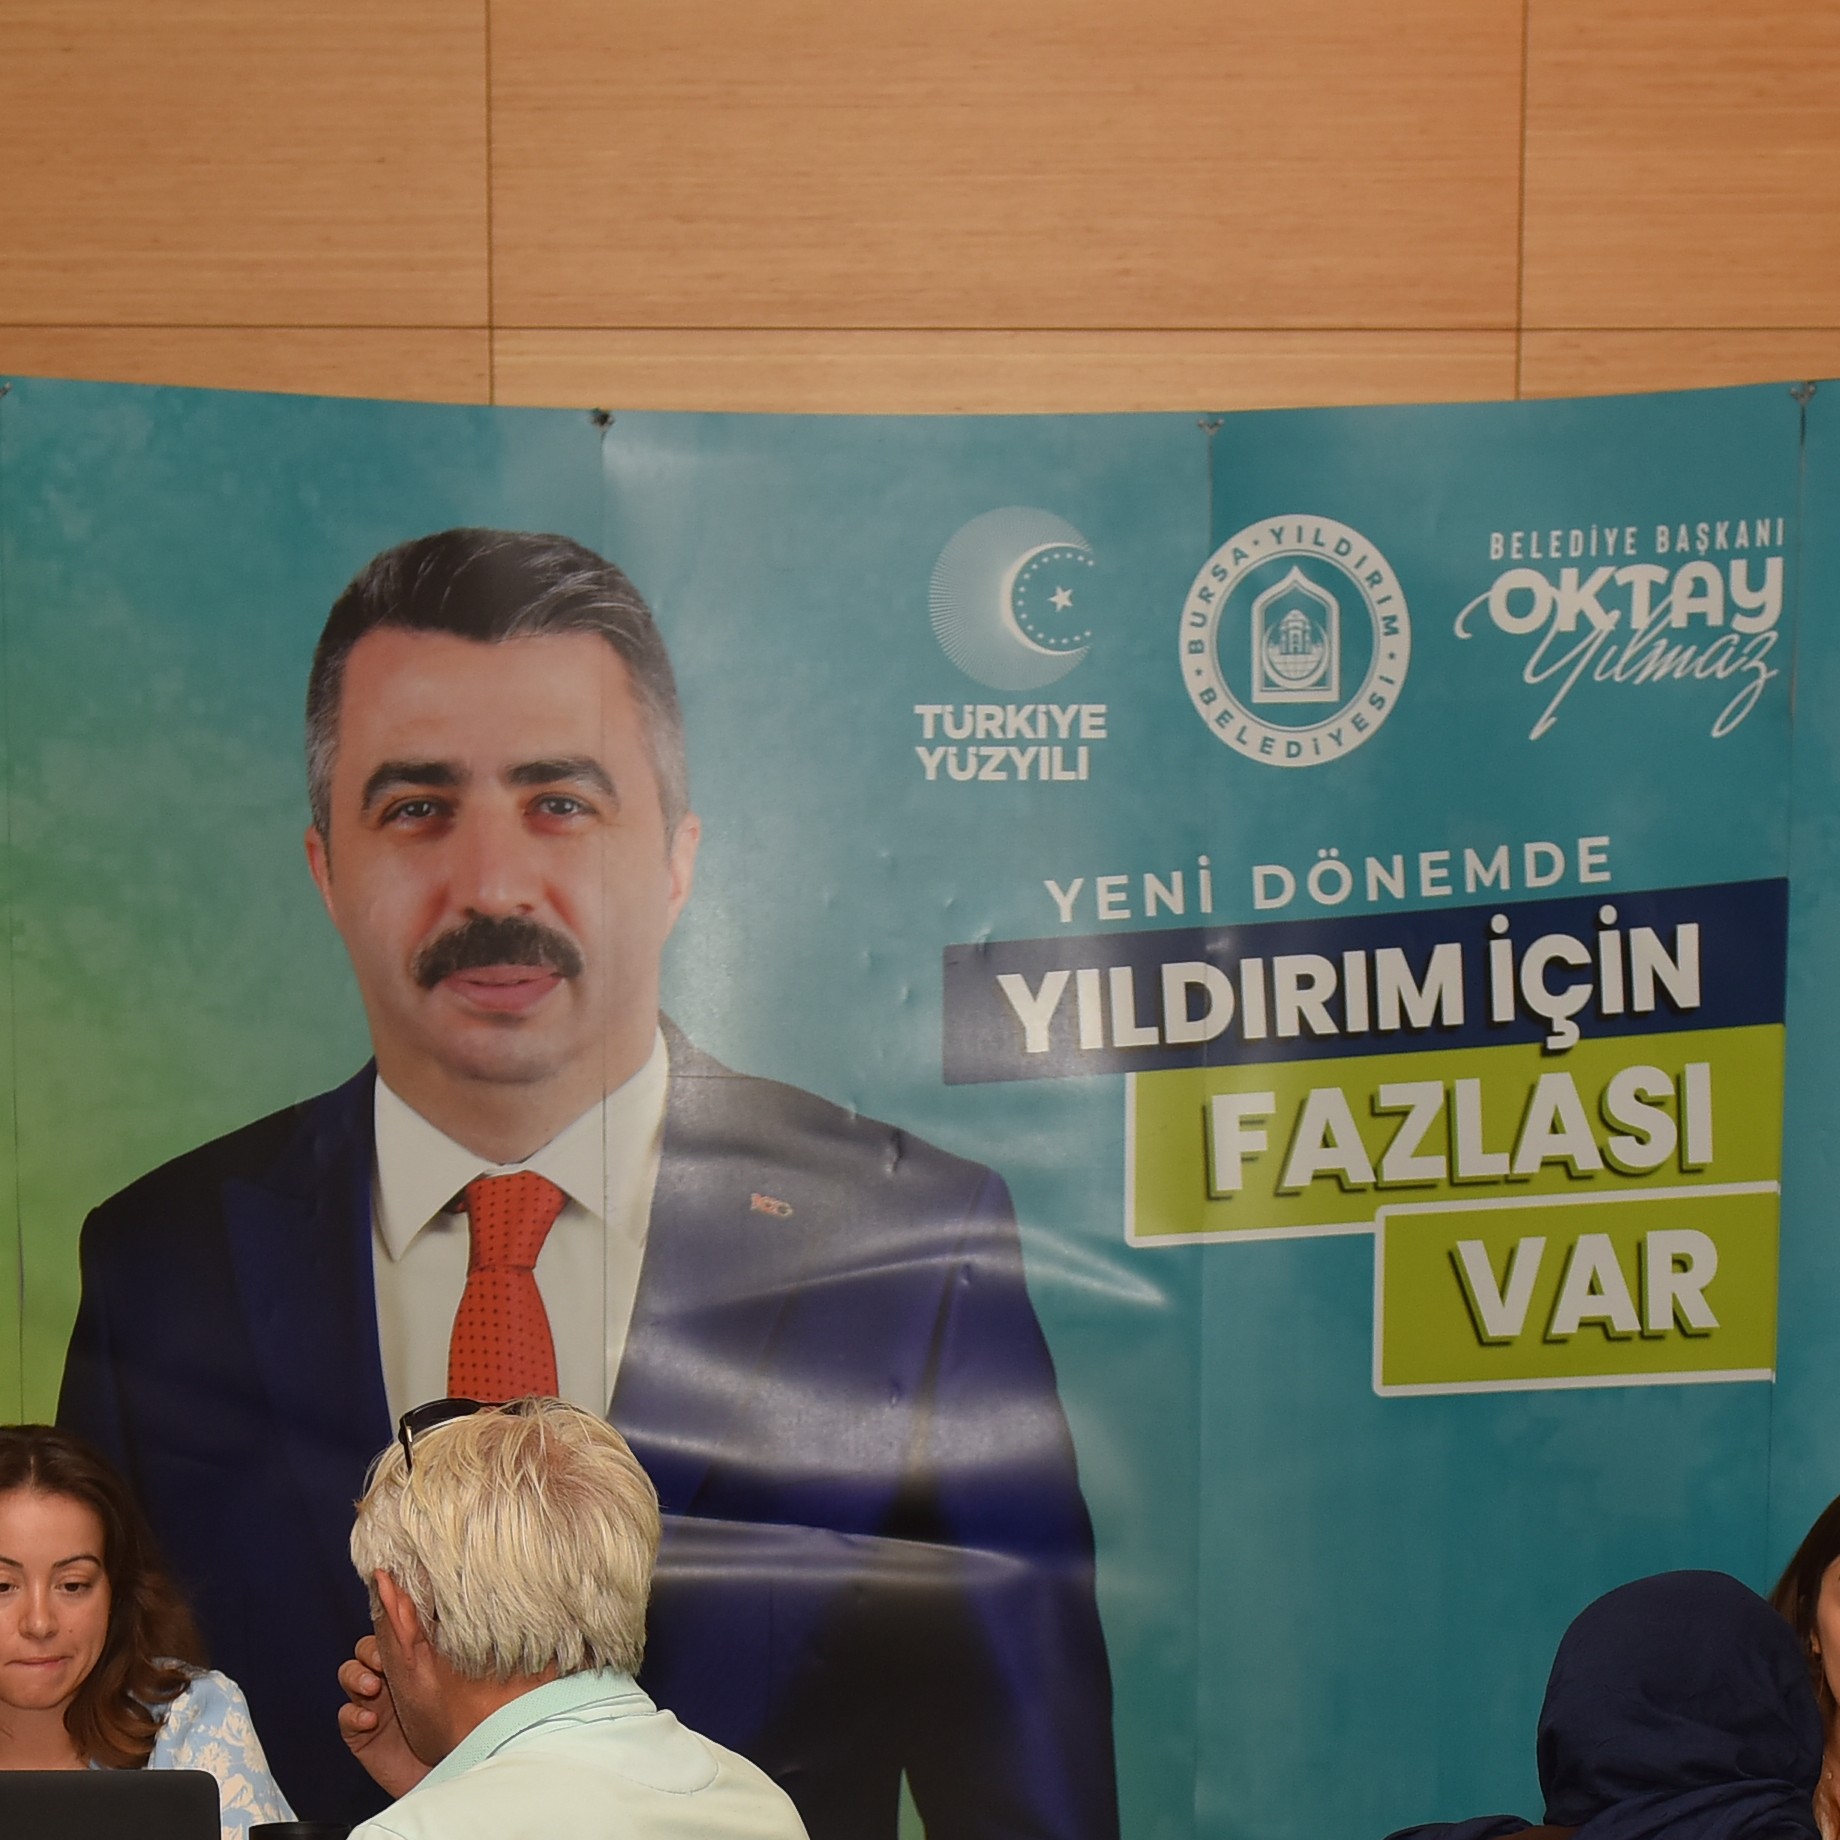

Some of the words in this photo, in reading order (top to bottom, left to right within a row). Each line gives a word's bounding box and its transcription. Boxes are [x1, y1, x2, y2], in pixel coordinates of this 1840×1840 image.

[1489, 524, 1638, 561] BELEDİYE
[1655, 517, 1785, 556] BAŞKANI
[1187, 546, 1250, 655] BURSA
[1269, 525, 1400, 637] YILDIRIM
[1488, 556, 1785, 635] OKTAY
[913, 703, 1109, 740] TÜRKİYE
[914, 745, 1090, 781] YÜZYILI
[1043, 854, 1215, 923] YENİ
[1251, 835, 1613, 911] DÖNEMDE
[997, 938, 1465, 1055] YILDIRIM
[1489, 904, 1701, 1052] İÇİN
[1203, 1061, 1715, 1199] FAZLASI
[1454, 1227, 1720, 1346] VAR
